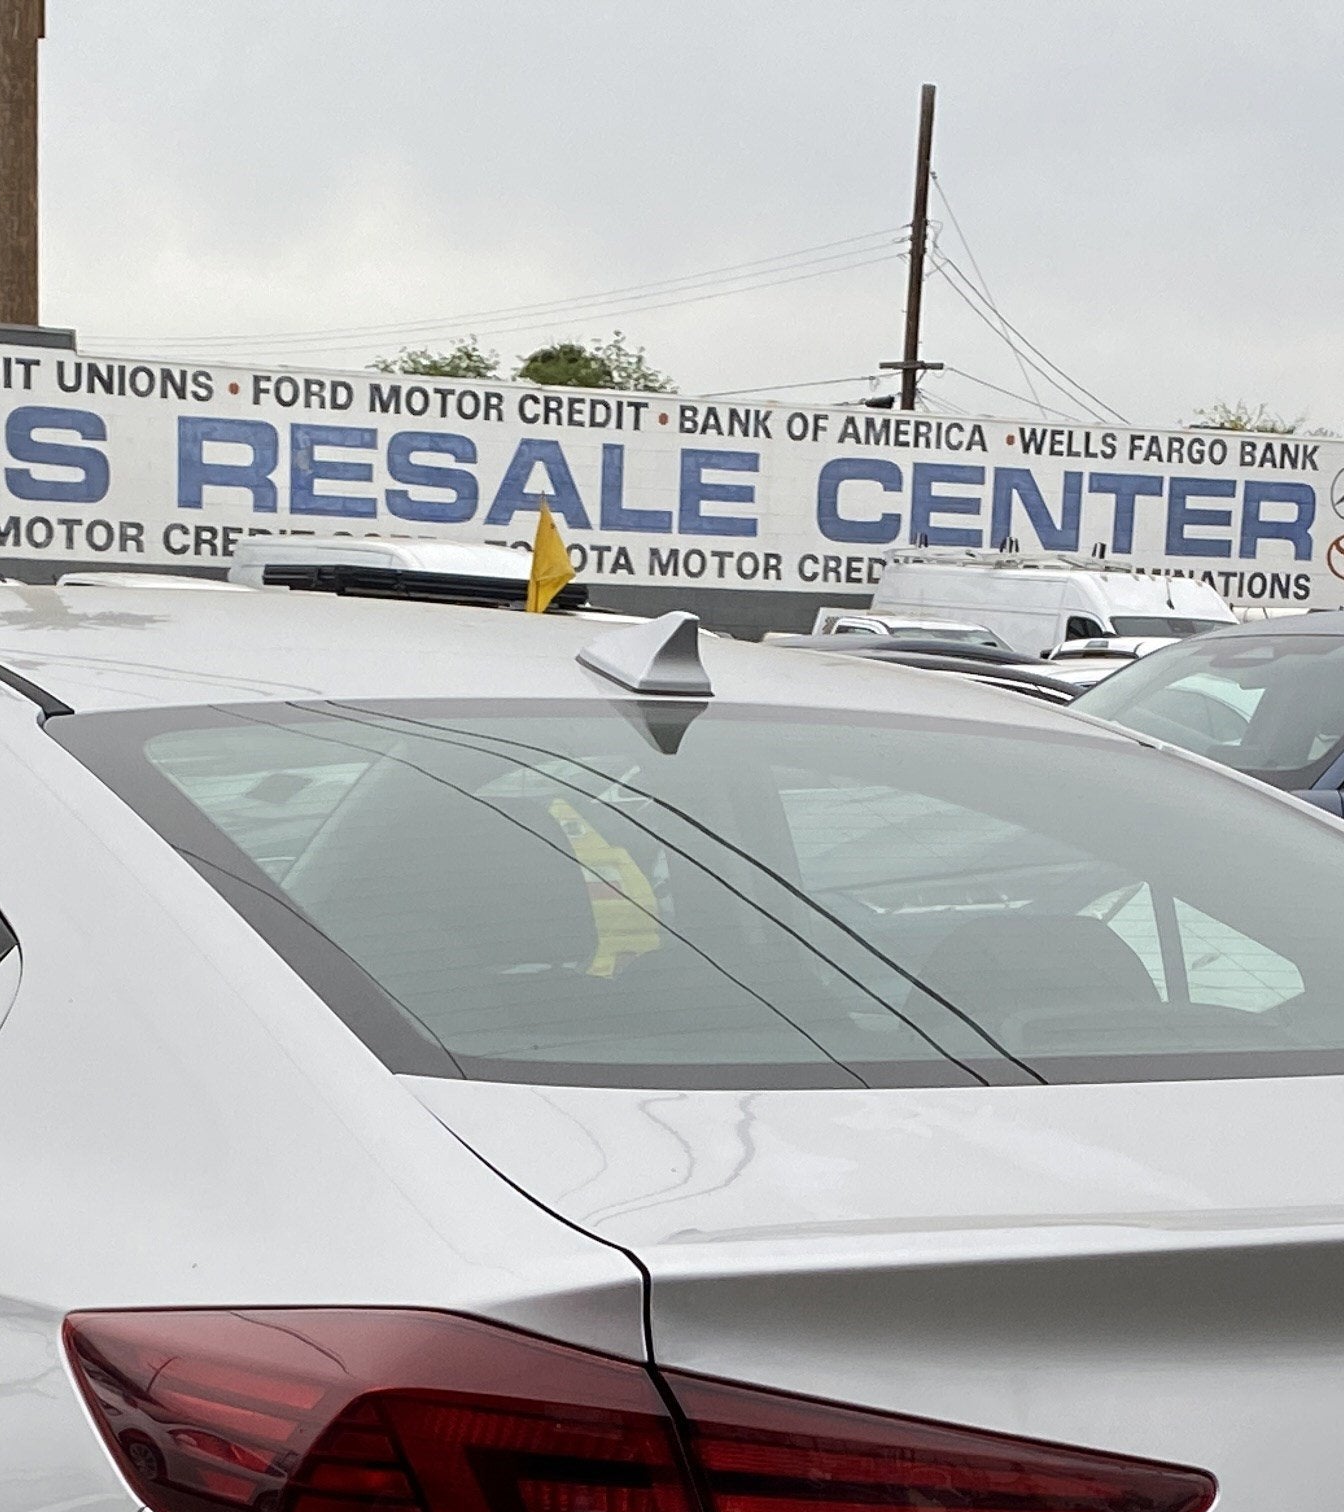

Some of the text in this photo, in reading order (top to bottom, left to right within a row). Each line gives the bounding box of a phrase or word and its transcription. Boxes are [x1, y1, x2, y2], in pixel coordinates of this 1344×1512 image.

[56, 360, 214, 402] UNIONS
[252, 375, 354, 411] FORD
[369, 383, 504, 422] MOTOR
[518, 393, 649, 431] CREDIT
[679, 405, 773, 439] BANK
[787, 411, 829, 442] OF
[838, 415, 988, 452] AMERICA
[1019, 427, 1117, 459] WELLS
[1129, 434, 1227, 465] FARGO
[1239, 440, 1320, 471] BANK
[178, 415, 760, 538] RESALE
[817, 457, 1316, 561] CENTER
[648, 547, 782, 580] MOTOR
